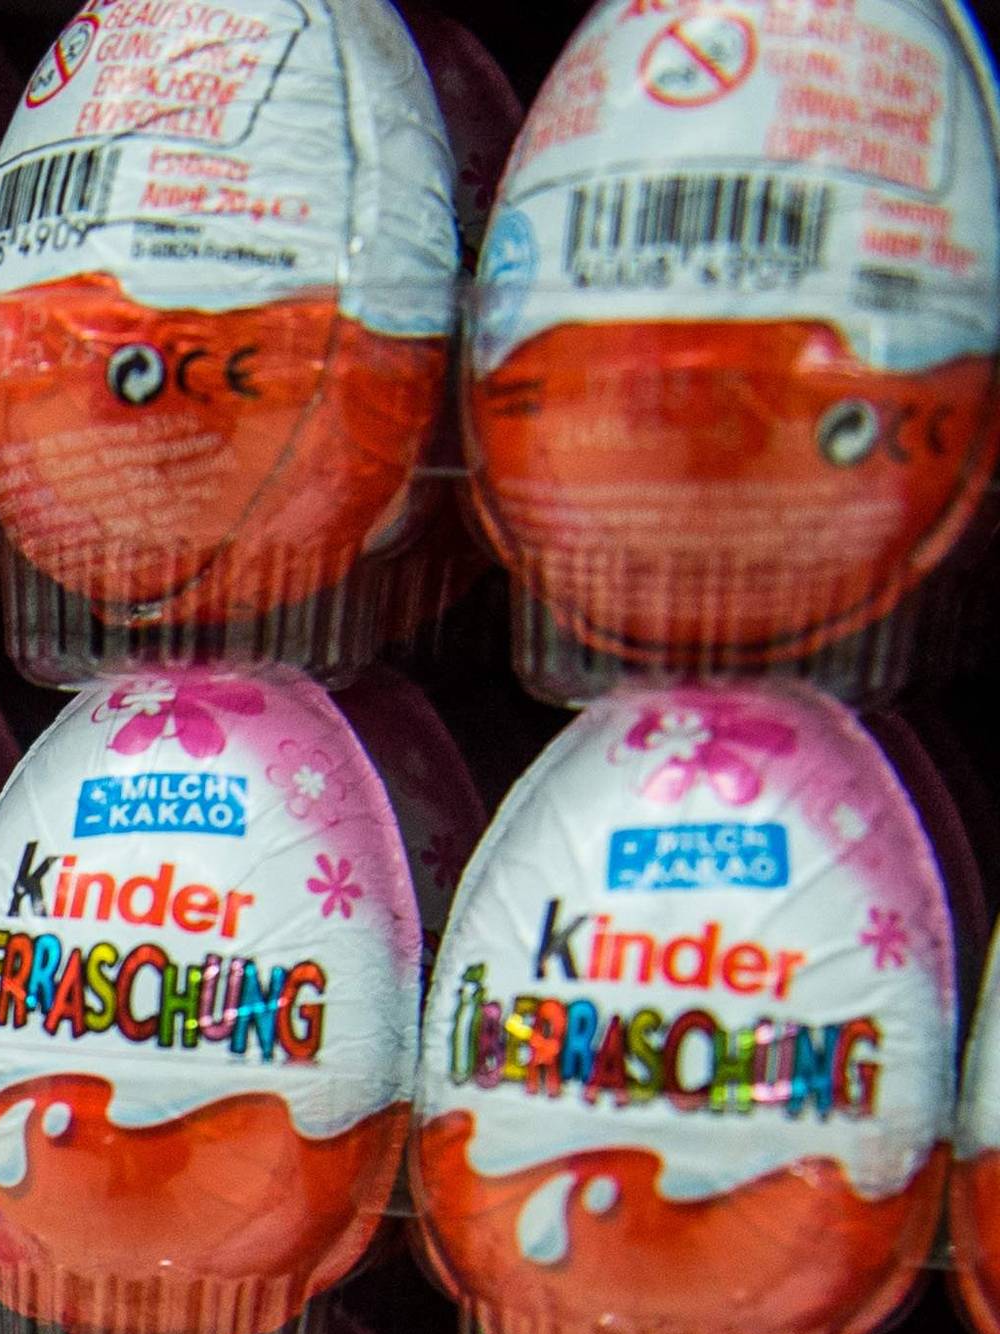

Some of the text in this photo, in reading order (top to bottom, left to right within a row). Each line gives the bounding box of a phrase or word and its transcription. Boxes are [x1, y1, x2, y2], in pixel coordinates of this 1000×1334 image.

[108, 803, 233, 828] KAKAO
[121, 776, 230, 800] MILCH
[8, 841, 254, 939] Kinder
[533, 899, 807, 1000] Kinder
[449, 962, 883, 1122] ÜBERRASCHUNG
